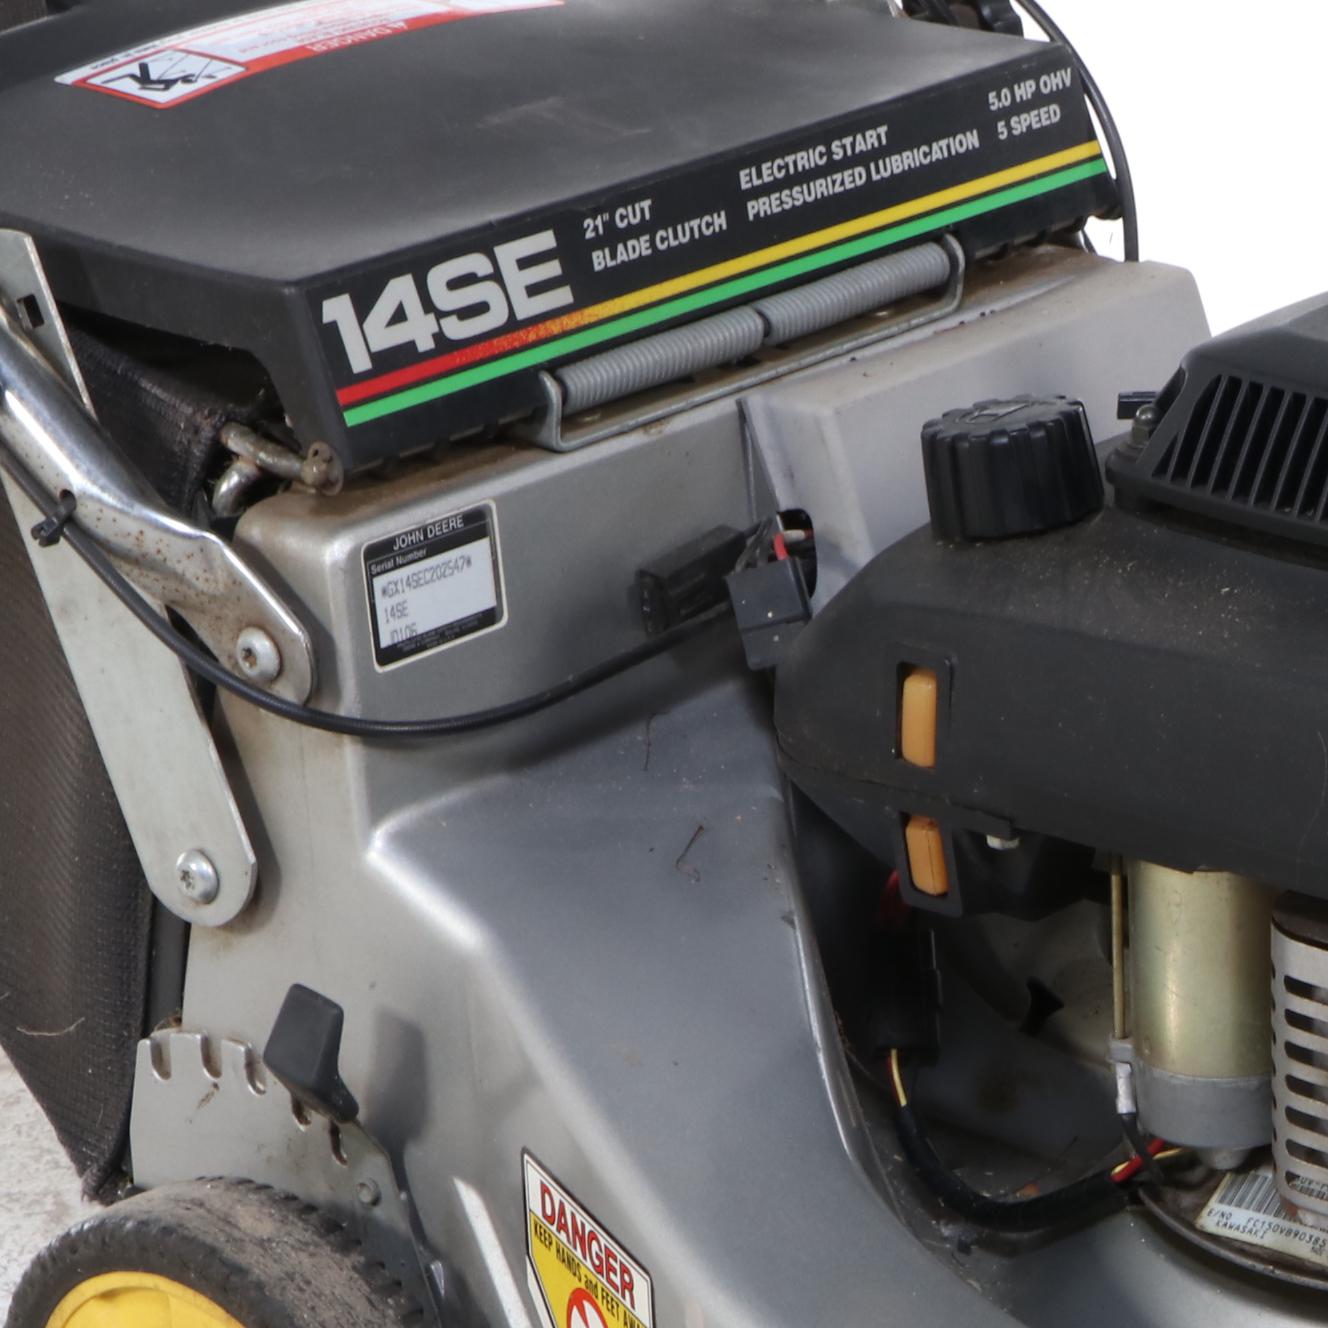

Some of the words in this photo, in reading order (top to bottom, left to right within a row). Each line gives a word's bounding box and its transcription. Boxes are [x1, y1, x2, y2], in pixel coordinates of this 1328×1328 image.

[988, 88, 1012, 111] 5.0
[1013, 81, 1037, 105] HP
[1039, 67, 1073, 97] OHV
[996, 120, 1008, 141] 5
[1010, 104, 1061, 138] SPEED
[738, 143, 828, 191] ELECTRIC
[830, 125, 889, 163] START
[746, 166, 868, 223] PRESSURIZED
[870, 130, 980, 184] LUBRICATION
[583, 215, 609, 241] 21"
[614, 199, 653, 231] CUT
[592, 240, 652, 273] BLADE
[654, 210, 727, 250] CLUTCH
[321, 229, 575, 375] 14SE
[393, 528, 424, 551] JOHN
[427, 514, 465, 538] DEERE
[370, 559, 394, 575] Serial
[396, 547, 427, 566] Number
[384, 600, 409, 624] 14SE
[540, 1179, 636, 1311] DANGER
[1215, 1219, 1267, 1240] KAWASAKI
[533, 1219, 553, 1250] KEEP
[556, 1243, 582, 1284] HANDS
[584, 1273, 598, 1300] and
[601, 1289, 620, 1321] FEET
